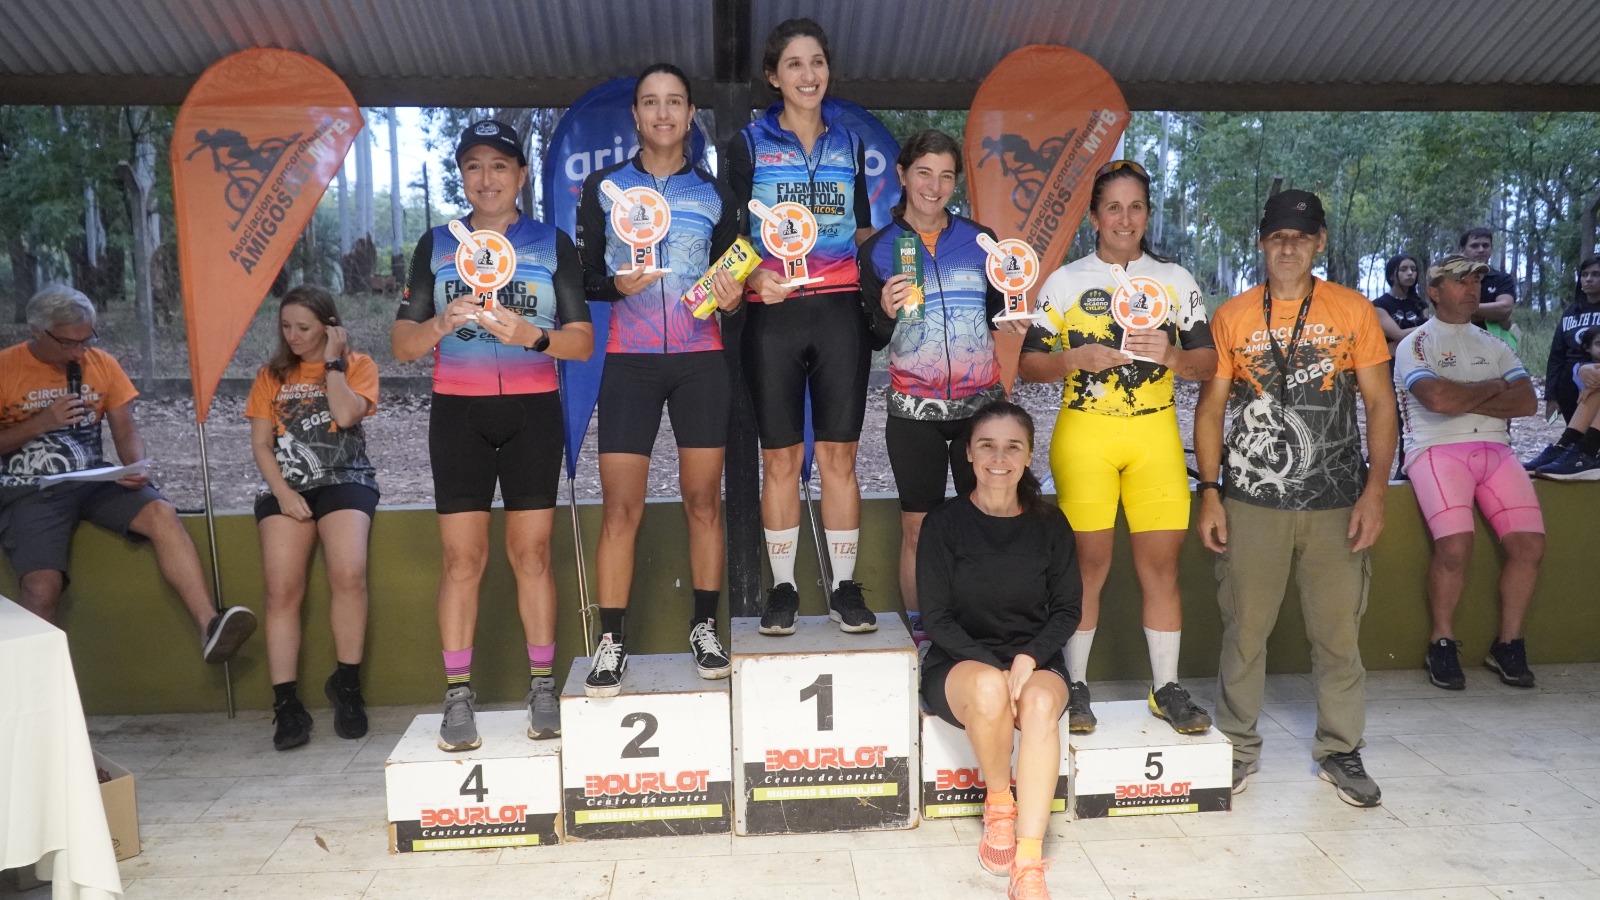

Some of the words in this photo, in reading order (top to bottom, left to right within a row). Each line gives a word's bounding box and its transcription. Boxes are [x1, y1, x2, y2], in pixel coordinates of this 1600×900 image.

[1026, 192, 1055, 246] ociación
[1052, 109, 1101, 190] concordiense
[1033, 186, 1072, 262] MIGOS
[1083, 108, 1118, 155] MTB
[777, 181, 838, 194] FLEMING
[239, 190, 294, 275] AMIGOS
[308, 118, 350, 163] MTB
[900, 247, 916, 255] PURO
[901, 255, 916, 264] SOL
[445, 280, 526, 295] FLNG
[1251, 323, 1326, 342] CIRCUTO
[1298, 338, 1311, 347] EL
[1311, 335, 1336, 345] MTB
[1285, 358, 1335, 389] 2026
[28, 384, 90, 401] CIRCUO
[281, 383, 322, 392] CIRCU
[22, 399, 55, 411] AMIG
[301, 411, 333, 431] 202
[800, 673, 834, 731] 1
[620, 712, 660, 759] 2
[765, 746, 888, 771] BOURLOT
[1144, 752, 1164, 780] 5
[459, 764, 489, 802] 4
[585, 770, 710, 796] BOURLOT
[765, 775, 814, 784] Centro
[818, 773, 833, 782] de
[838, 773, 883, 781] cortes
[766, 787, 816, 798] MADERAS
[819, 788, 828, 796] &
[829, 786, 883, 795] HERRAJES
[937, 793, 984, 801] Centro
[1115, 782, 1191, 799] BOURLOT
[586, 797, 636, 806] Centro
[641, 795, 656, 804] de
[661, 795, 707, 803] cortes
[420, 804, 528, 828] BOURLOT
[588, 809, 640, 821] MADERAS
[422, 829, 465, 837] Centro
[469, 827, 483, 835] de
